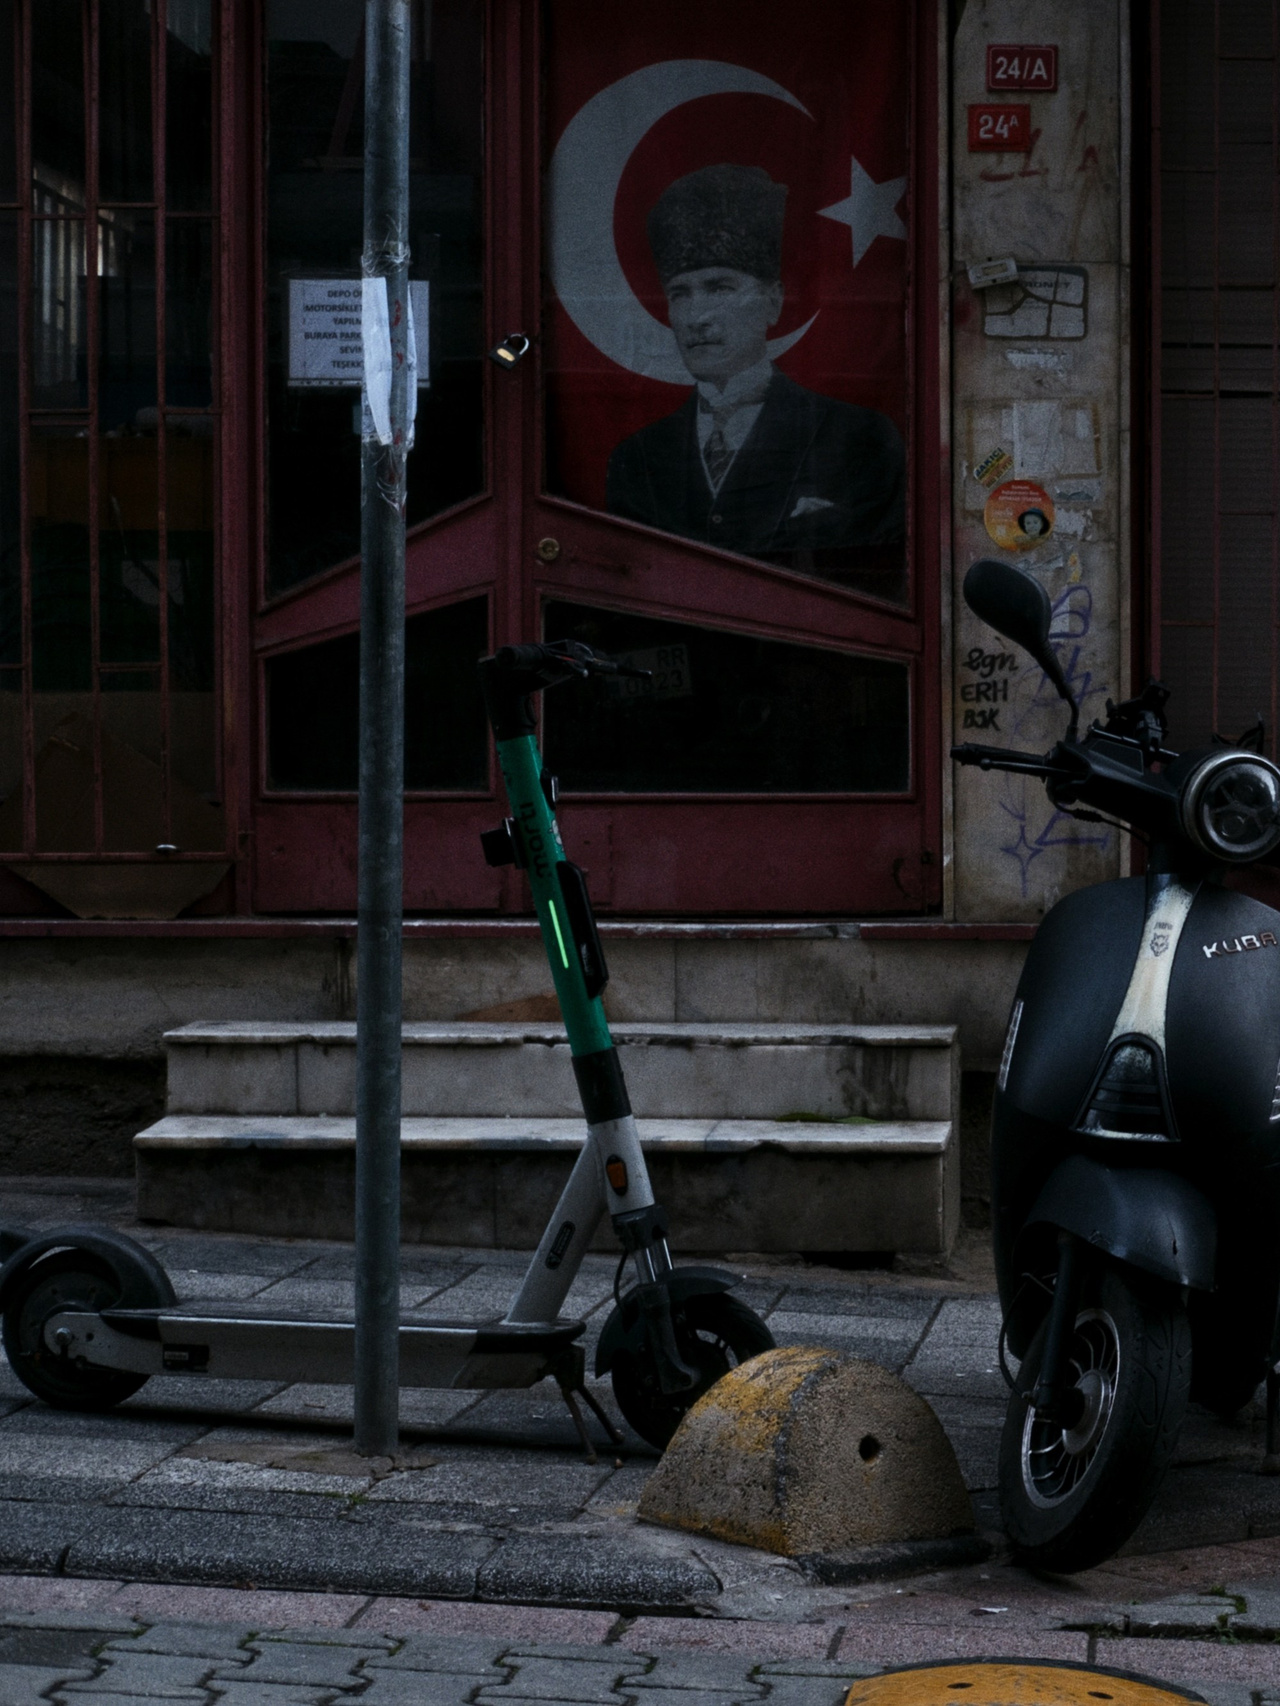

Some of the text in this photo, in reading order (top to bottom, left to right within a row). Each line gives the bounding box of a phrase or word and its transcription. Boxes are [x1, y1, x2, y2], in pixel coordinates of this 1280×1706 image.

[995, 56, 1048, 80] 24/A
[327, 290, 351, 298] DEPO
[304, 331, 337, 340] BURAYA
[961, 679, 1008, 702] ERH
[1202, 932, 1278, 959] KUBA
